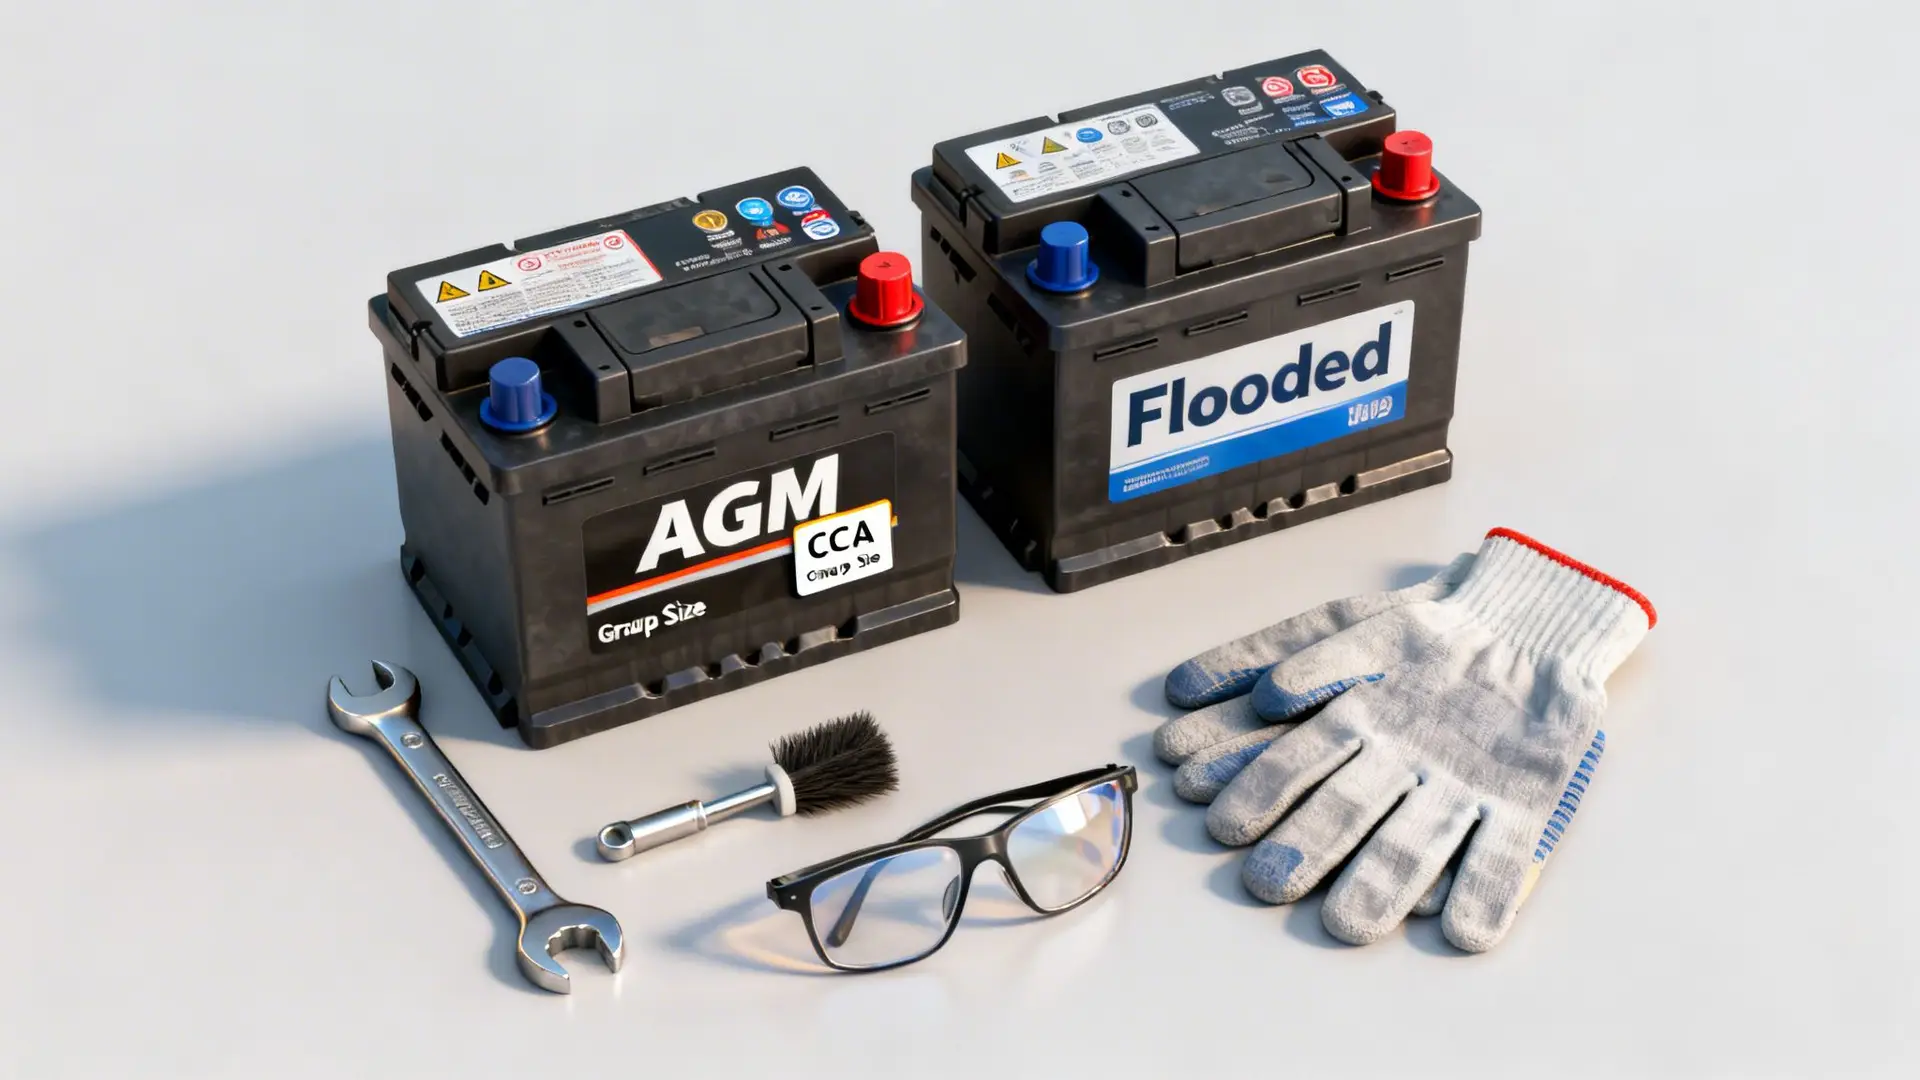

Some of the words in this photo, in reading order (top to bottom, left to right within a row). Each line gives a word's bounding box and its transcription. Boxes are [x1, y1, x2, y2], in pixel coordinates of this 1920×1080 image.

[1127, 321, 1392, 447] Flooded
[635, 453, 839, 574] AGM
[808, 520, 874, 559] CCA
[662, 600, 707, 626] Size
